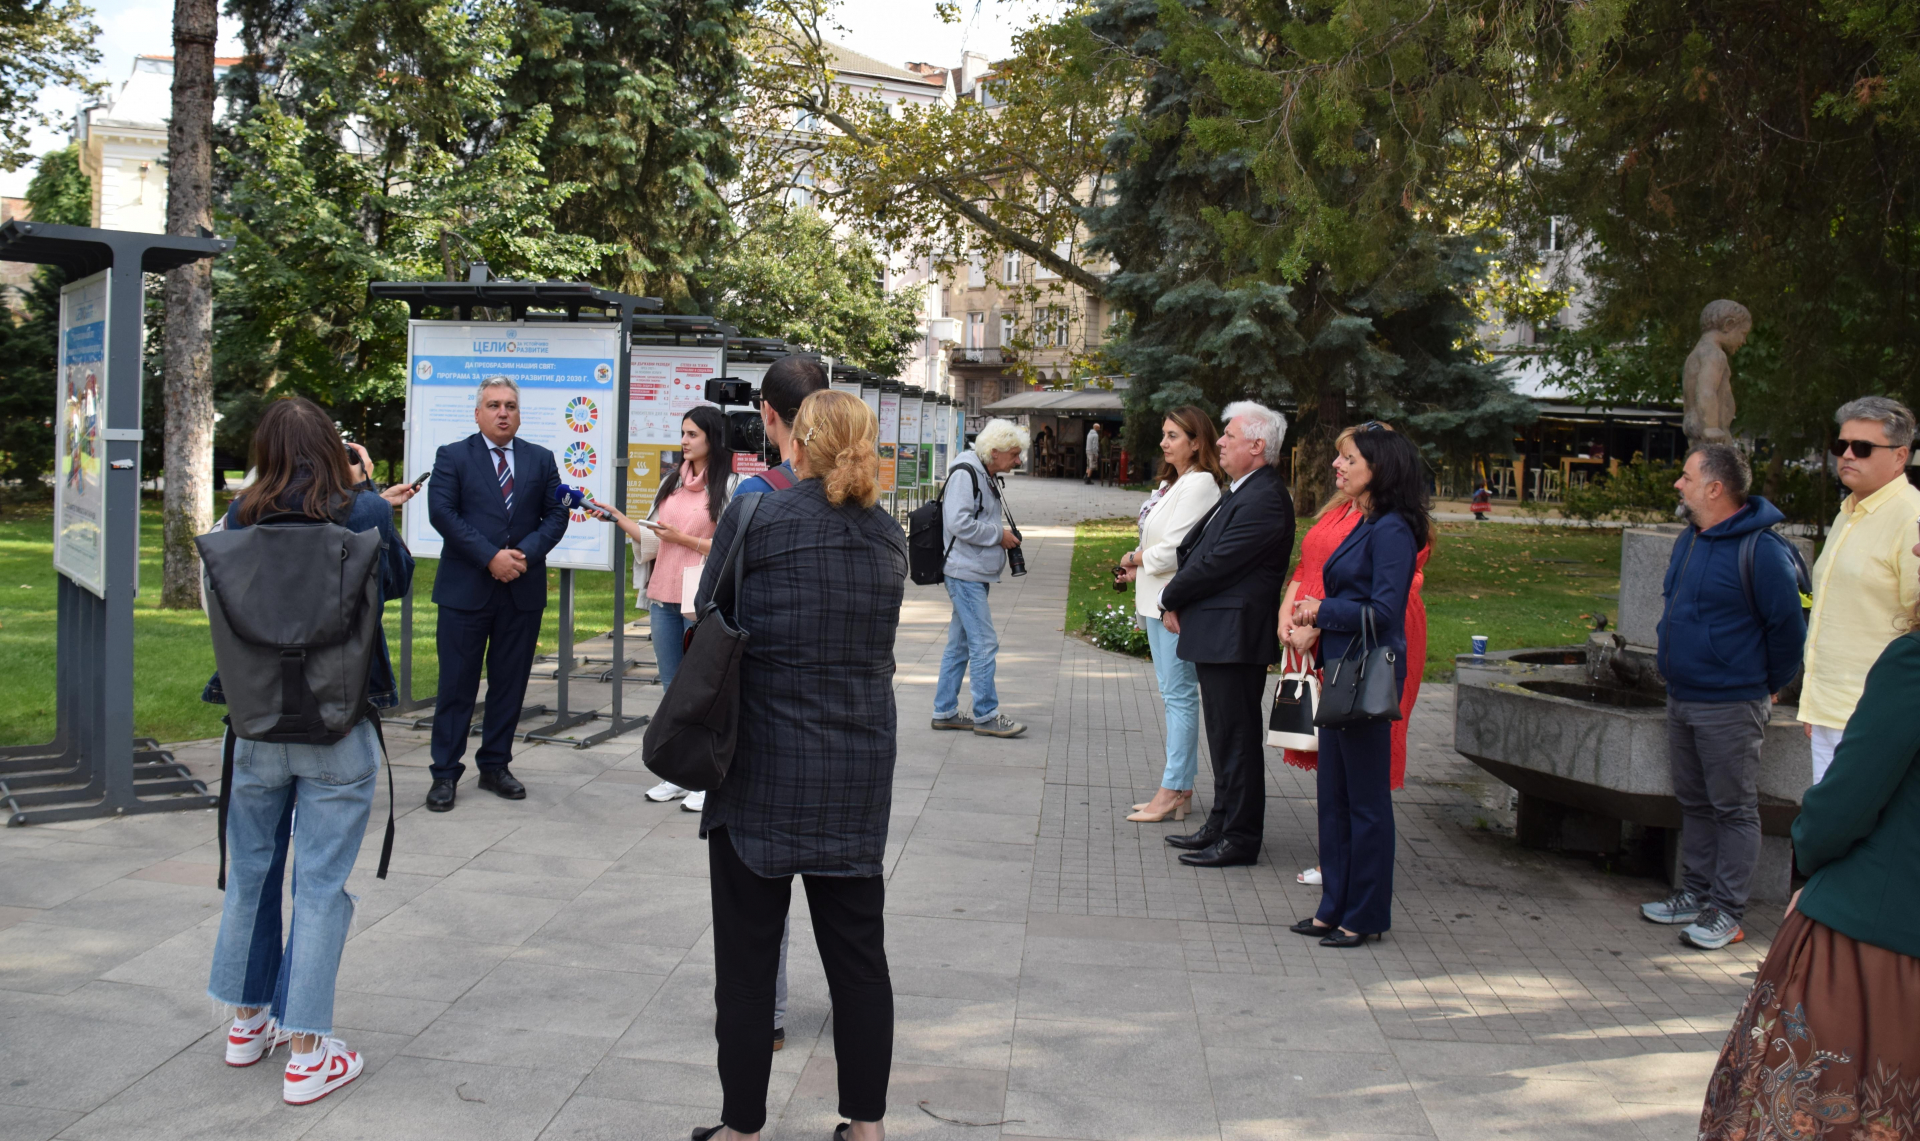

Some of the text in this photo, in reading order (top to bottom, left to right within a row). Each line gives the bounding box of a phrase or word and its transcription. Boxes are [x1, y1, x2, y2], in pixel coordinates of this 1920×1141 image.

[473, 341, 507, 354] ЦЕЛИ
[464, 361, 473, 370] ДА
[474, 361, 515, 369] ПРЕОБРАЗИМ
[515, 362, 538, 370] НАШИЯ
[436, 372, 471, 380] ПРОГРАМА
[555, 374, 565, 383] ДО
